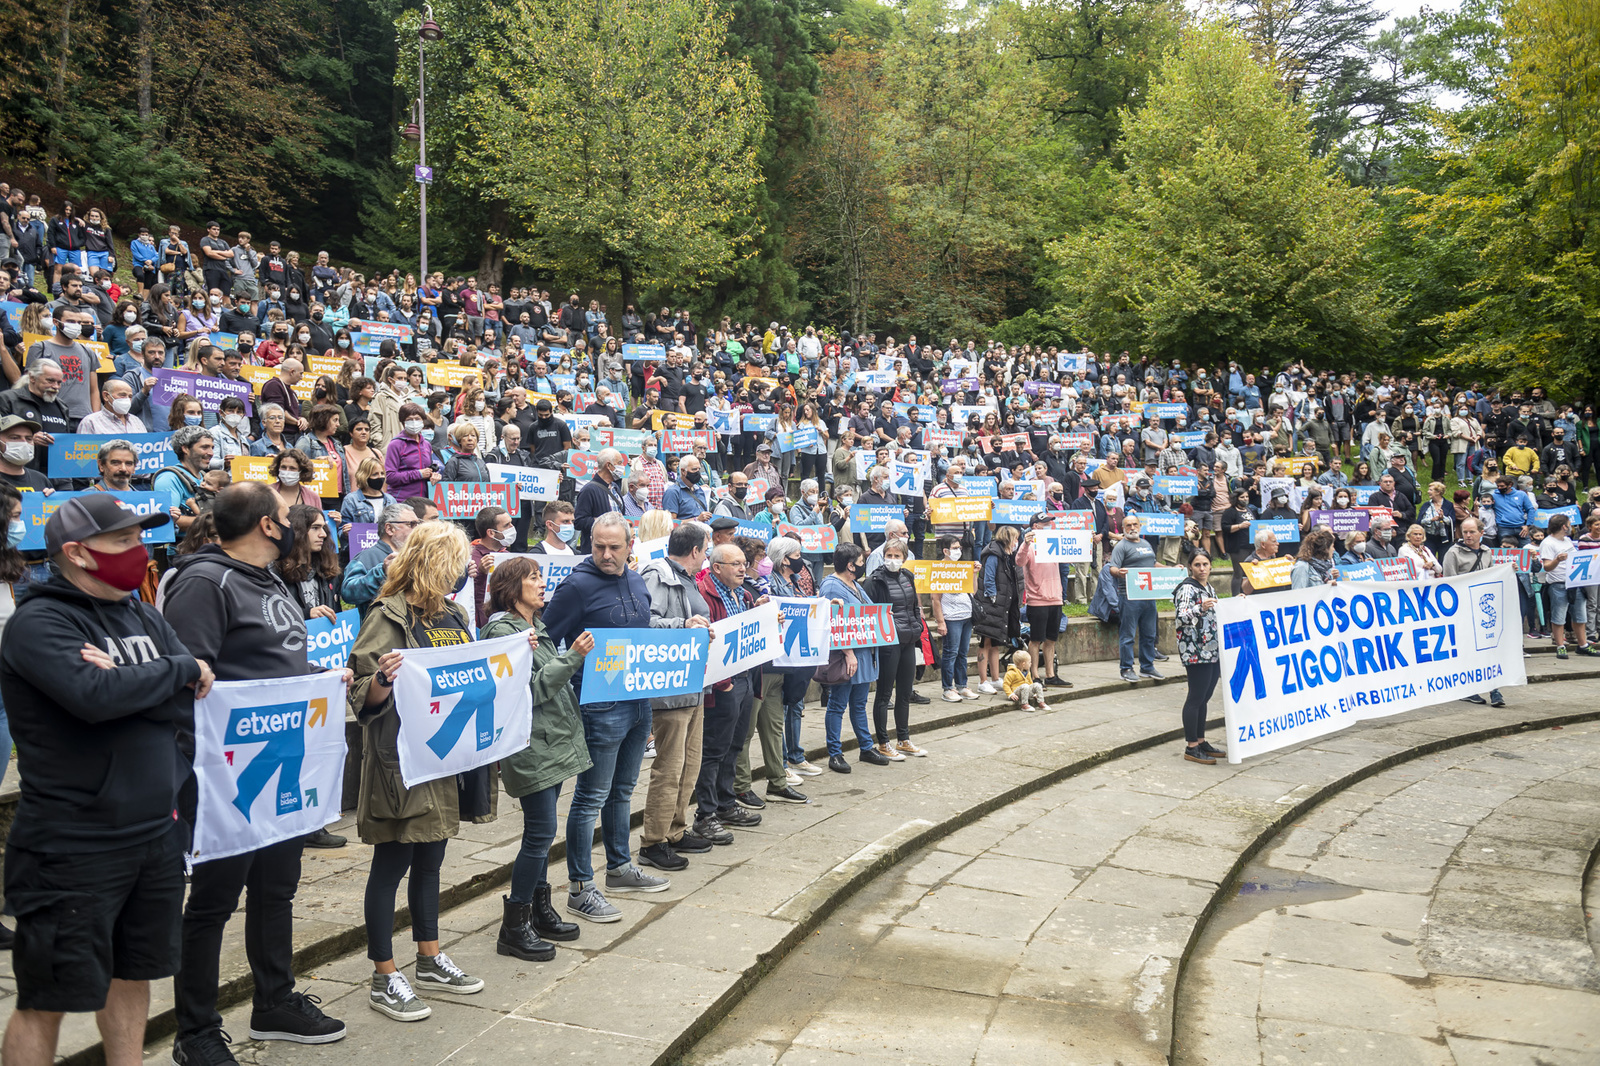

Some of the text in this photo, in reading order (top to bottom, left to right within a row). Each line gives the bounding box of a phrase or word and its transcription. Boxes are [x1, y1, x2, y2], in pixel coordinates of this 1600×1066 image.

[312, 363, 342, 372] presoa
[170, 376, 188, 387] izan
[195, 378, 248, 393] emakume
[164, 384, 188, 394] bidea
[74, 442, 99, 451] izan
[132, 436, 173, 454] soak
[65, 450, 98, 460] bidea
[134, 452, 165, 471] era!
[249, 463, 268, 472] izan
[244, 470, 268, 480] bidea
[518, 472, 539, 483] izan
[964, 480, 994, 490] presoak
[447, 490, 505, 502] Salbuespen
[968, 487, 991, 496] txera!
[42, 502, 61, 513] iza
[955, 503, 990, 513] presoak
[1008, 503, 1043, 513] presoak
[957, 511, 987, 521] etxera!
[1009, 512, 1031, 522] etxe
[1147, 516, 1180, 526] presoak
[1333, 517, 1360, 526] presoak
[1147, 525, 1176, 534] etxera!
[1333, 523, 1357, 531] etxera!
[1060, 535, 1077, 545] izan
[1061, 546, 1082, 557] bidea
[1492, 555, 1519, 563] uespen
[548, 562, 572, 577] iza
[930, 569, 968, 581] presoak
[930, 580, 963, 591] etxera!
[782, 605, 808, 617] etxera
[1260, 583, 1459, 650] BIZI OSORAKO
[307, 619, 355, 653] soak
[741, 620, 760, 641] izan
[830, 628, 878, 642] neurriekin
[605, 642, 625, 657] izan
[740, 634, 767, 660] bidea
[625, 637, 702, 671] presoak
[1276, 624, 1458, 695] ZIGORRIK EZ!
[595, 656, 625, 673] bidea
[435, 666, 488, 690] etxera
[624, 664, 689, 693] etxera!
[1238, 663, 1503, 743] ZA ESKUBIDEAK ELARBIZITZA KONPONBIDEA
[236, 709, 302, 737] etxera
[280, 797, 298, 806] bidea
